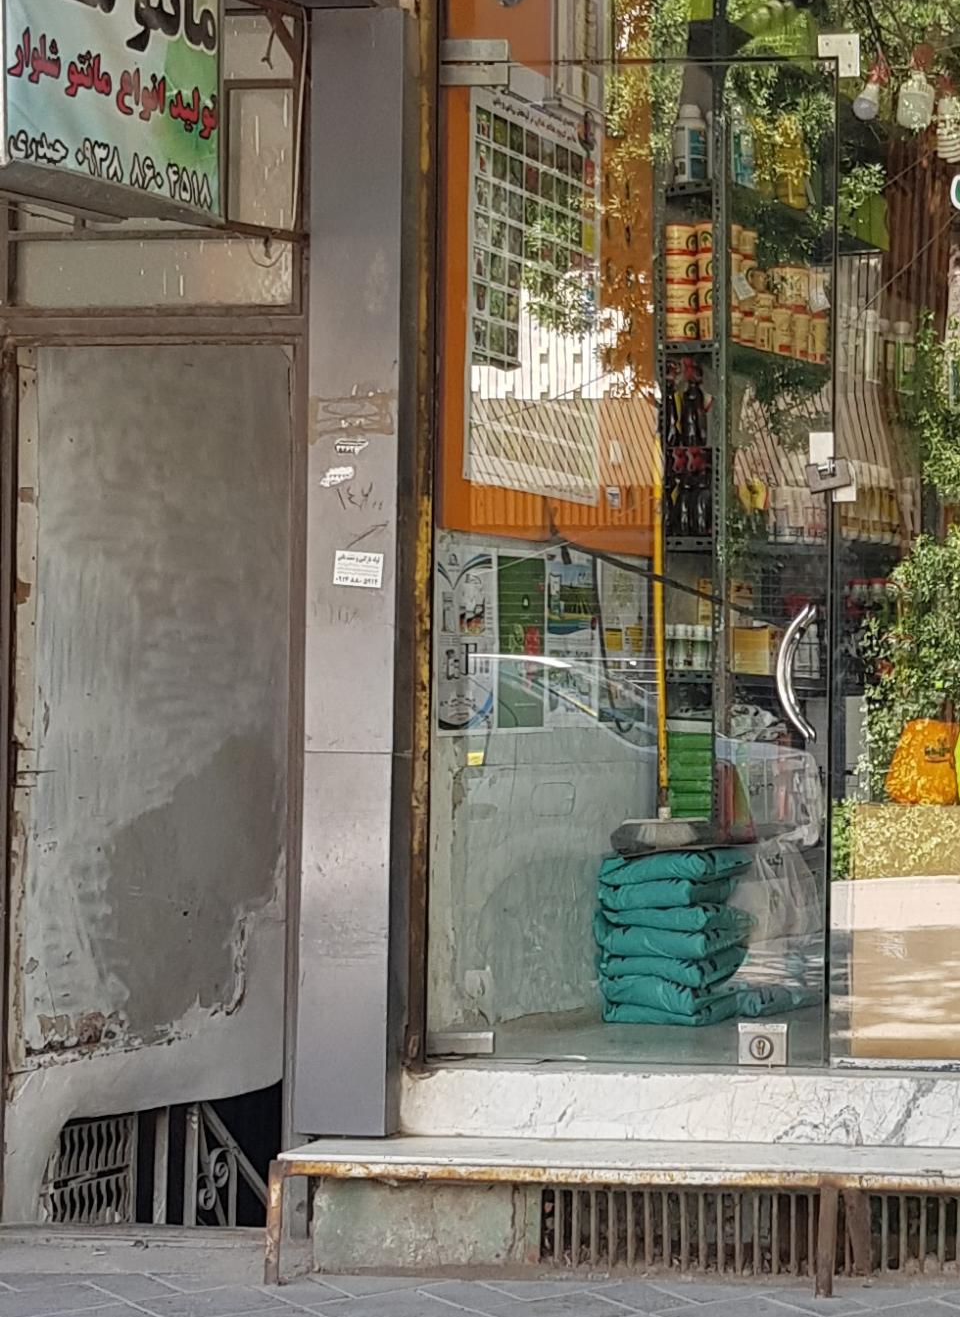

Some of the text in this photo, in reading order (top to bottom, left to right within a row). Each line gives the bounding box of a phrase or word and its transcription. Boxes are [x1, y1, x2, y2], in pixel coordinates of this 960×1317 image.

[8, 26, 218, 139] تولید انواع مانتو شلوار
[8, 130, 68, 164] حیدری
[75, 137, 124, 183] ۰۹۳۸
